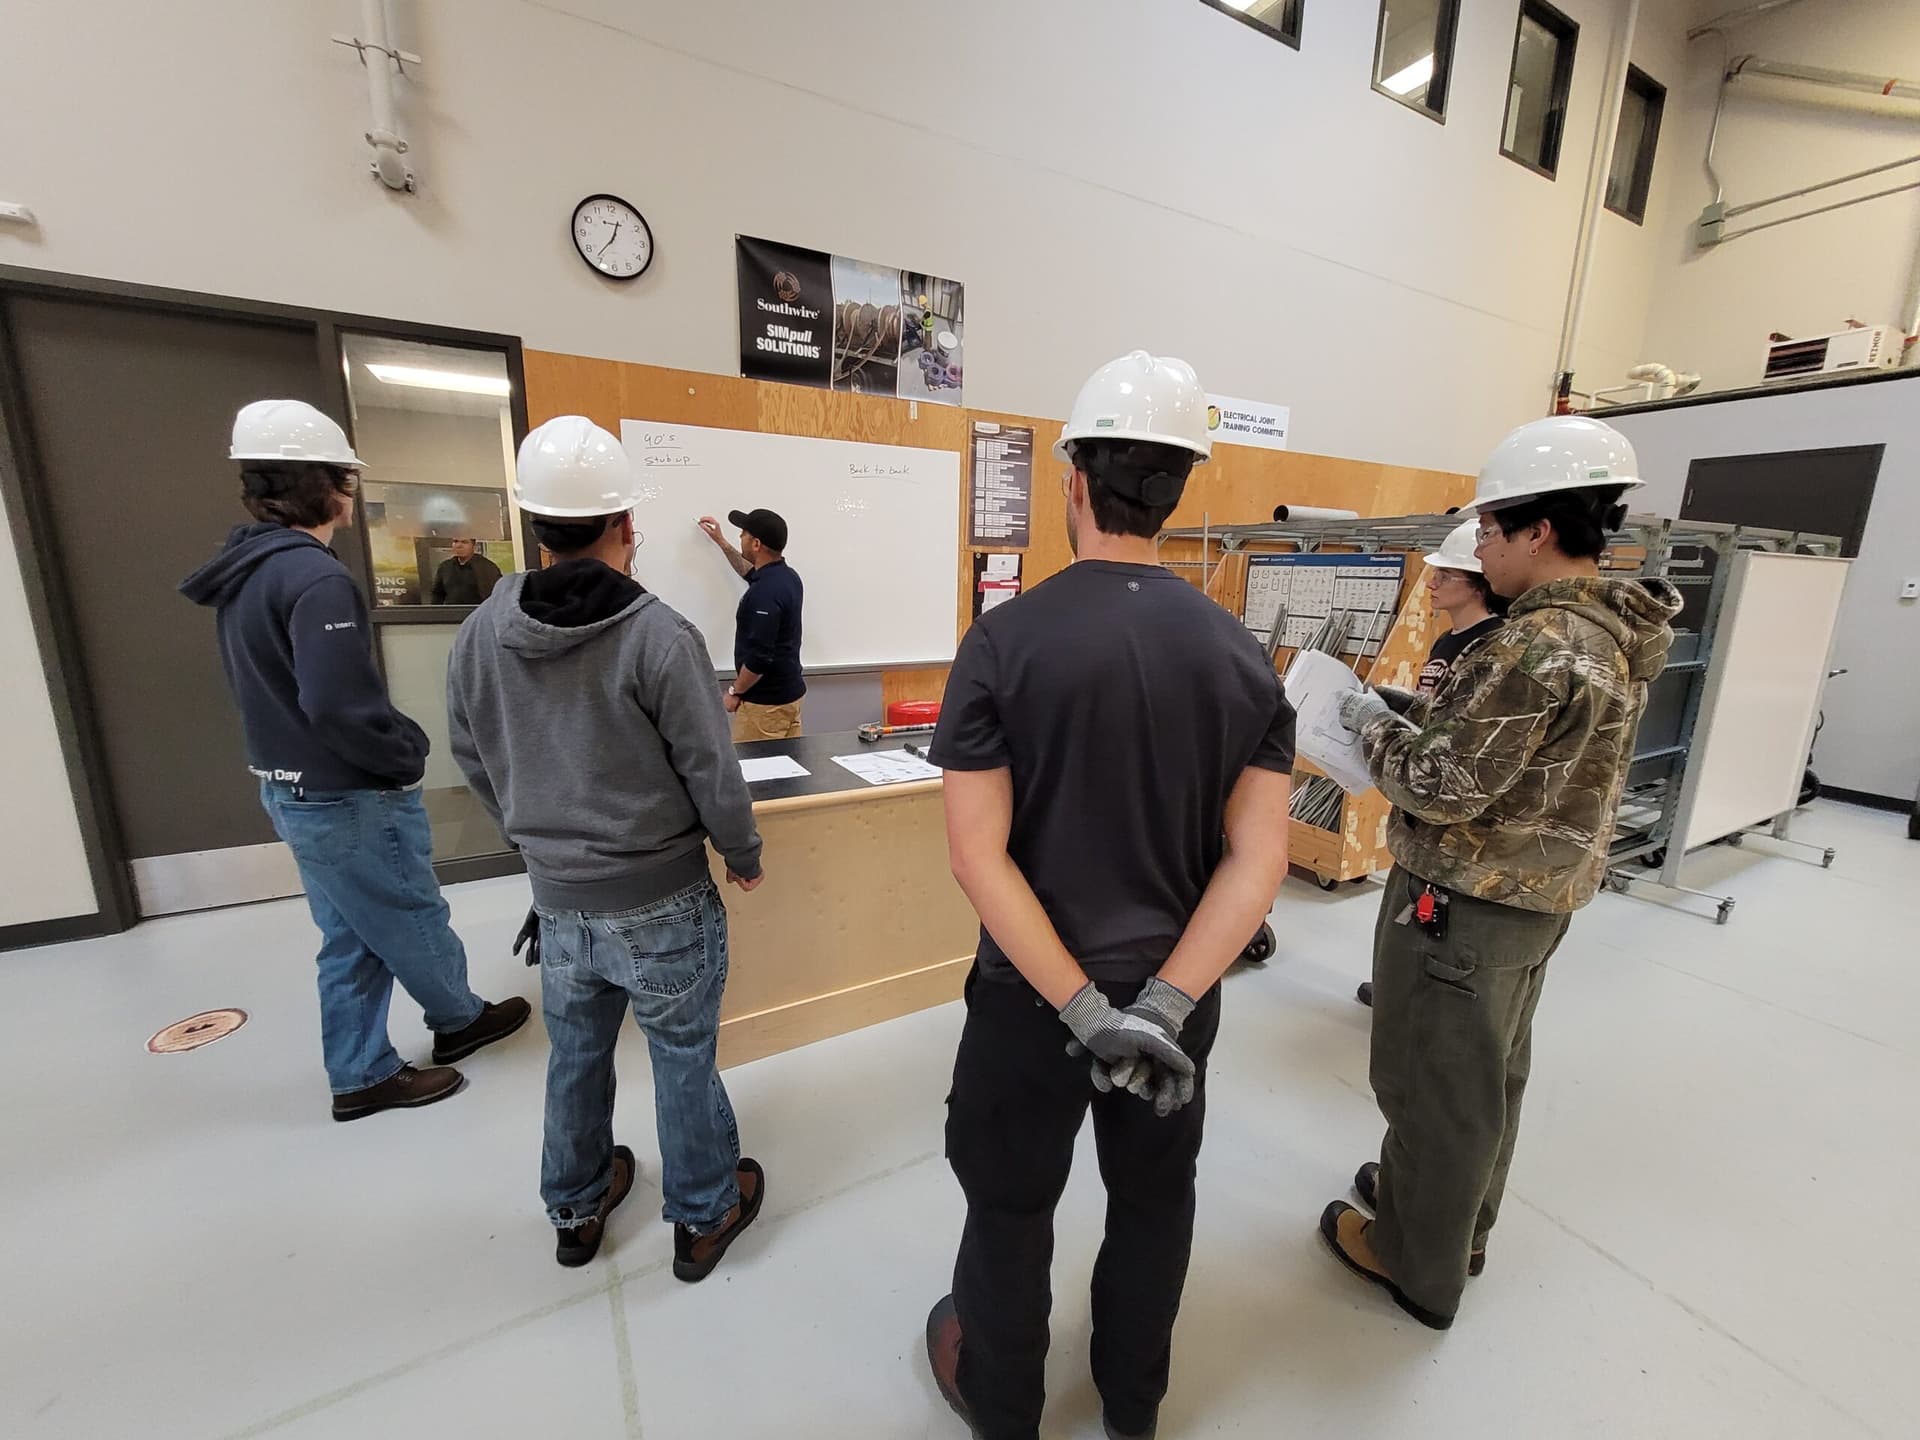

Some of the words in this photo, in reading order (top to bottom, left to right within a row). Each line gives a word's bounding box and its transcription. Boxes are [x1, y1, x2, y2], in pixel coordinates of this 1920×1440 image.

[607, 204, 616, 214] 12
[584, 215, 593, 224] 10
[580, 229, 587, 237] 9
[634, 225, 640, 233] 2
[586, 244, 592, 253] 8
[639, 241, 645, 249] 3
[611, 264, 618, 272] 6
[625, 262, 632, 271] 5
[767, 323, 812, 343] SIMpull
[756, 337, 820, 359] SOLUTIONS
[1223, 410, 1257, 423] ELECTRICAL
[1259, 417, 1276, 425] JOINT
[1222, 422, 1250, 433] TRAINING
[1252, 426, 1284, 437] COMMITTEE
[644, 433, 676, 446] 90's
[644, 453, 671, 465] Stub
[676, 456, 690, 465] up
[849, 463, 870, 474] Back
[875, 464, 885, 474] to
[274, 769, 303, 783] Day
